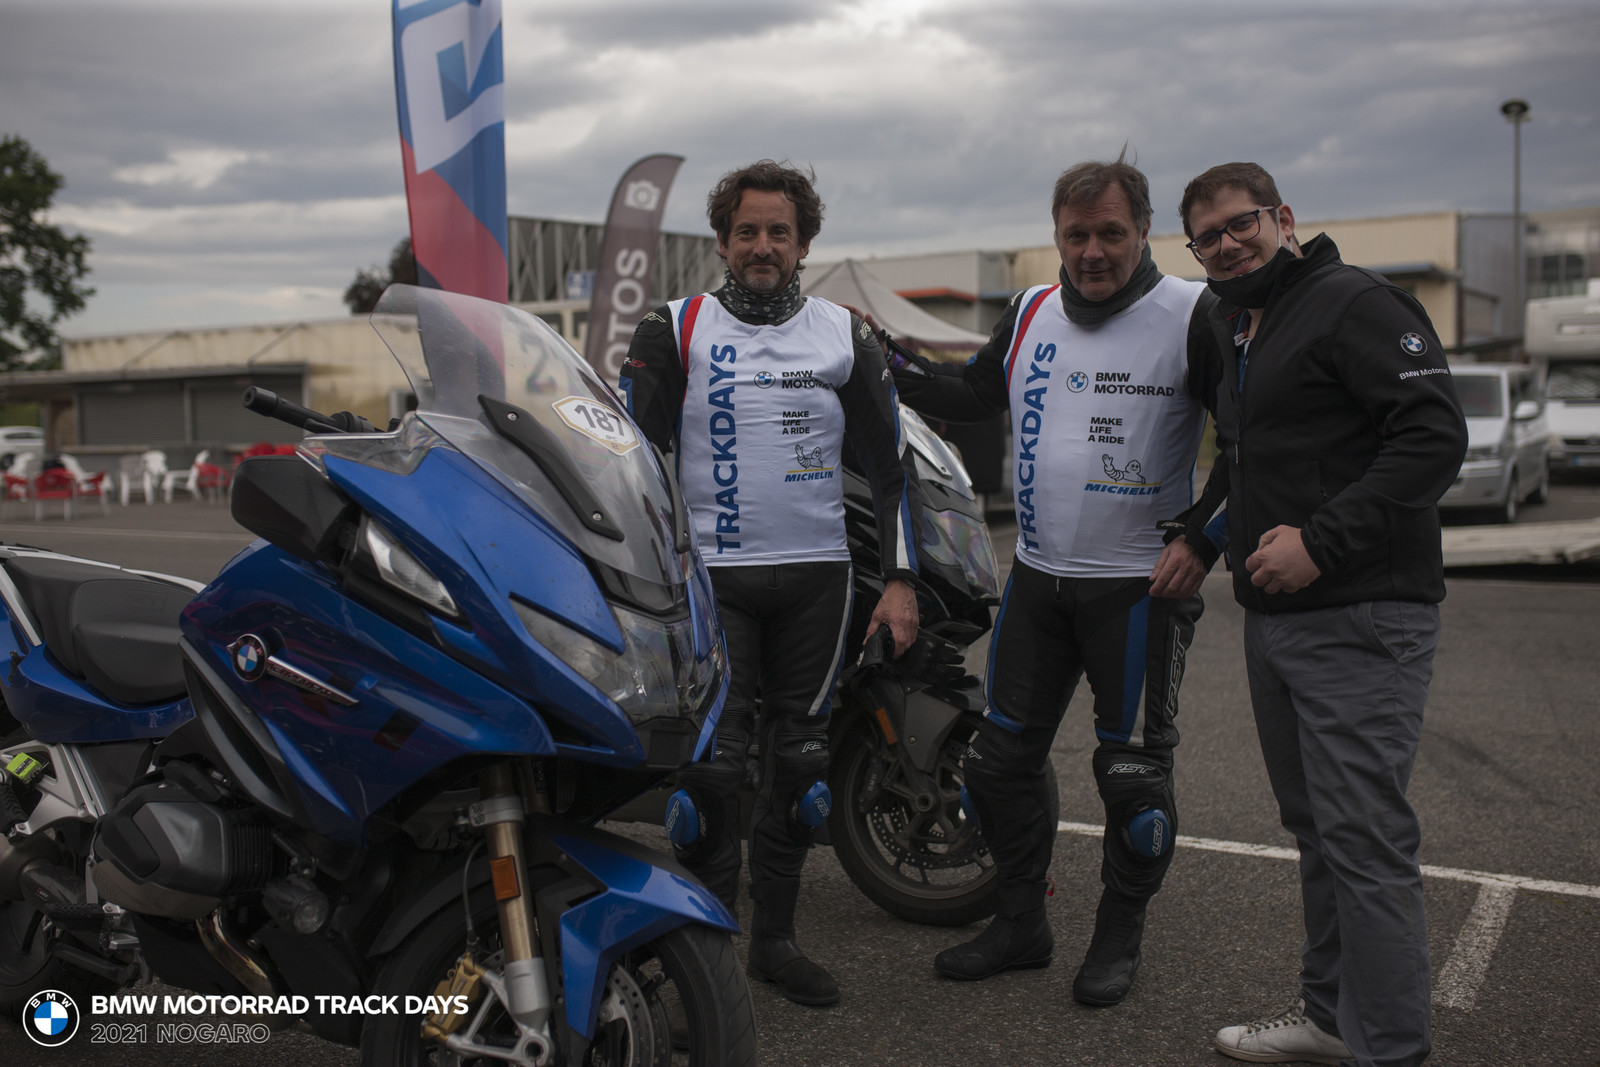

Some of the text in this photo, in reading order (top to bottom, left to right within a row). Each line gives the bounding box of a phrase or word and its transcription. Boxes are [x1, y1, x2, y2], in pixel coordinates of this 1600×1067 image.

[604, 247, 649, 388] OTOS
[782, 370, 813, 378] BMW
[1095, 372, 1131, 382] BMW
[1399, 370, 1420, 380] BMW
[1094, 384, 1175, 397] MOTORRAD
[782, 410, 810, 419] MAKE
[574, 404, 625, 437] 187
[782, 419, 802, 427] LIFE
[1090, 417, 1123, 426] MAKE
[782, 427, 810, 436] A RIDE
[1089, 426, 1112, 435] LIFE
[1087, 435, 1125, 445] A RIDE
[708, 343, 741, 554] TRACKDAYS
[1018, 341, 1057, 552] TRACKDAYS
[784, 470, 834, 482] MICHELIN
[1084, 483, 1162, 496] MICHELIN
[1107, 763, 1157, 775] RST
[1152, 819, 1164, 857] RST
